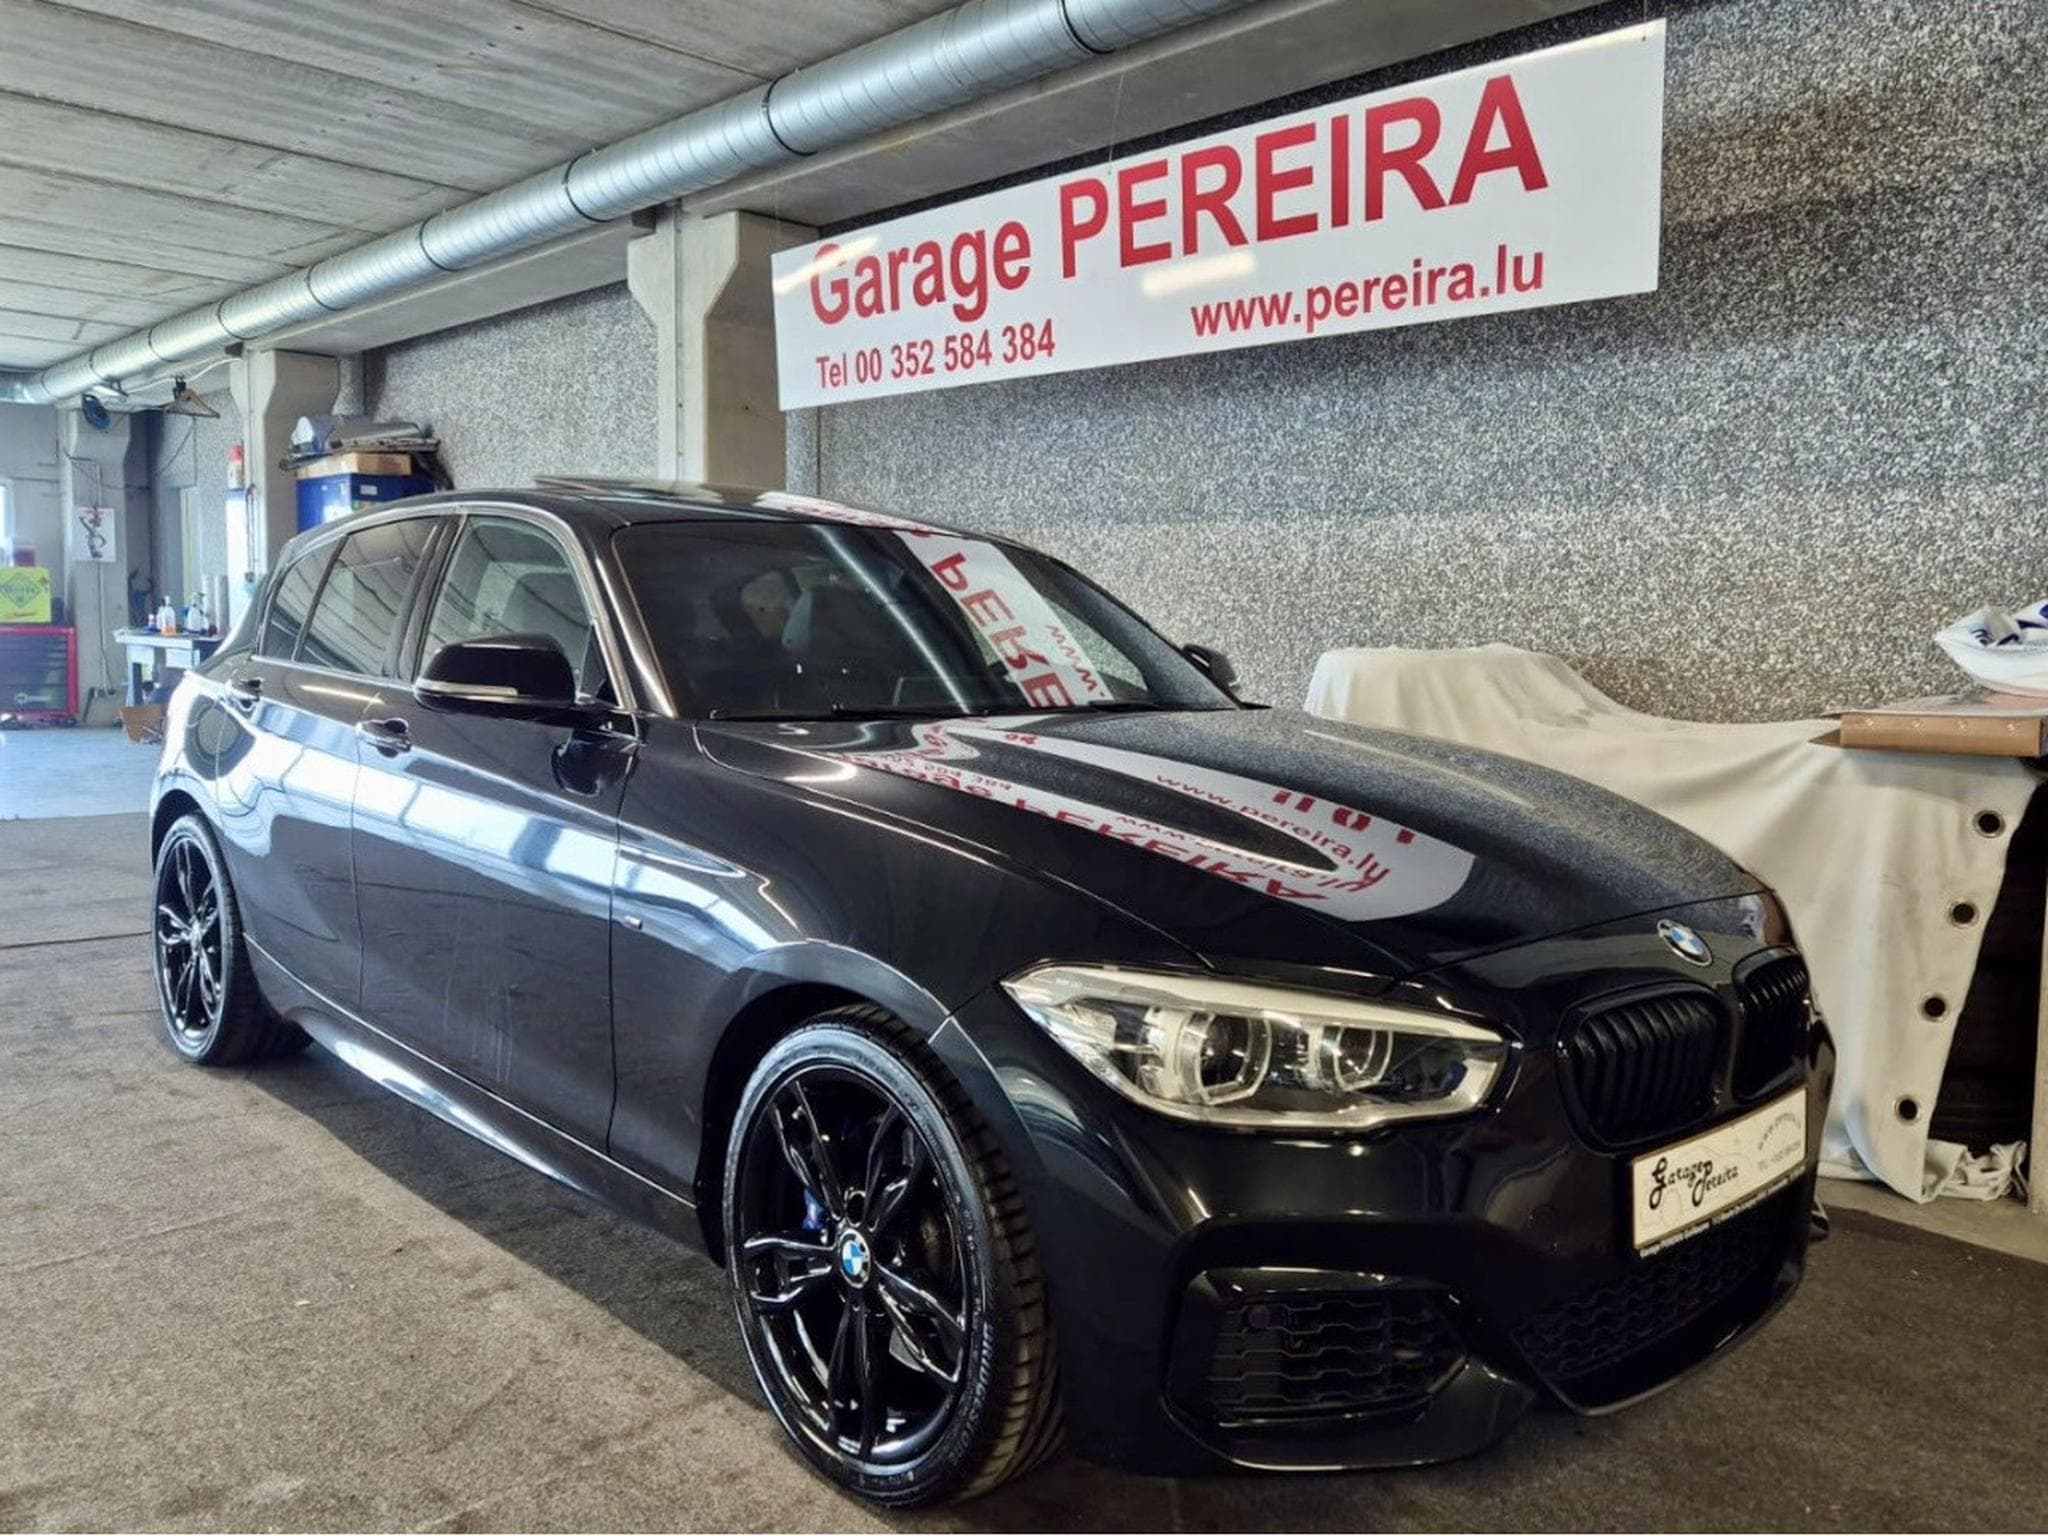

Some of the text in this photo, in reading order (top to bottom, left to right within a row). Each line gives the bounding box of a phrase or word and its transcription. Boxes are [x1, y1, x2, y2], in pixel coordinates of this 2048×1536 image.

[810, 75, 1548, 325] Garage PEREIRA
[1191, 245, 1545, 338] www.pereira.lu
[816, 317, 1056, 388] Tel 00 352 584 384
[1649, 1156, 1706, 1210] Garage
[1691, 1159, 1739, 1207] Pereira
